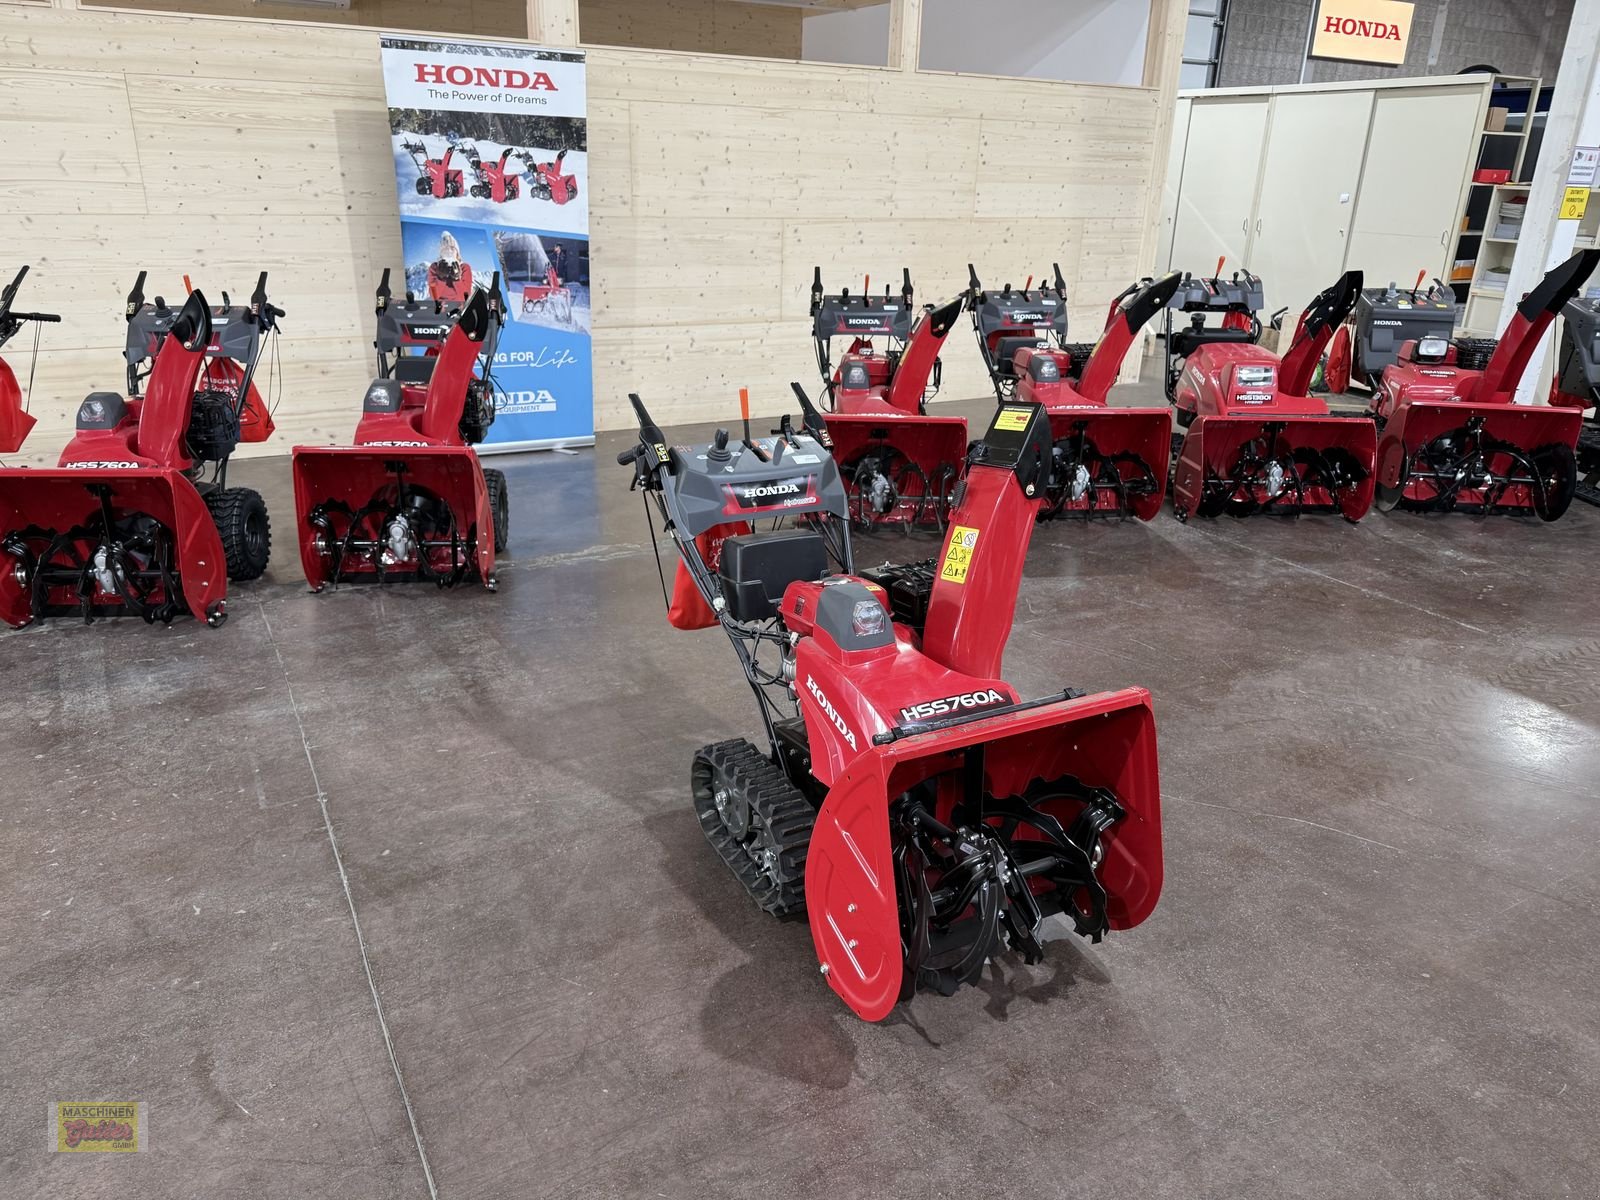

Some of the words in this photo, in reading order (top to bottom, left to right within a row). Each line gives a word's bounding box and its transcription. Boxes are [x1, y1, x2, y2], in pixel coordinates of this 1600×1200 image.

[1323, 16, 1402, 41] HONDA
[414, 63, 559, 91] HONDA
[427, 89, 449, 100] The
[452, 90, 489, 102] Power
[490, 93, 503, 103] of
[505, 93, 548, 105] Dreams
[510, 351, 534, 362] FOR
[529, 346, 579, 369] Life
[66, 461, 139, 469] HSS760A
[744, 484, 800, 499] HONDA
[806, 674, 857, 752] HONDA
[901, 689, 1004, 722] HSS760A
